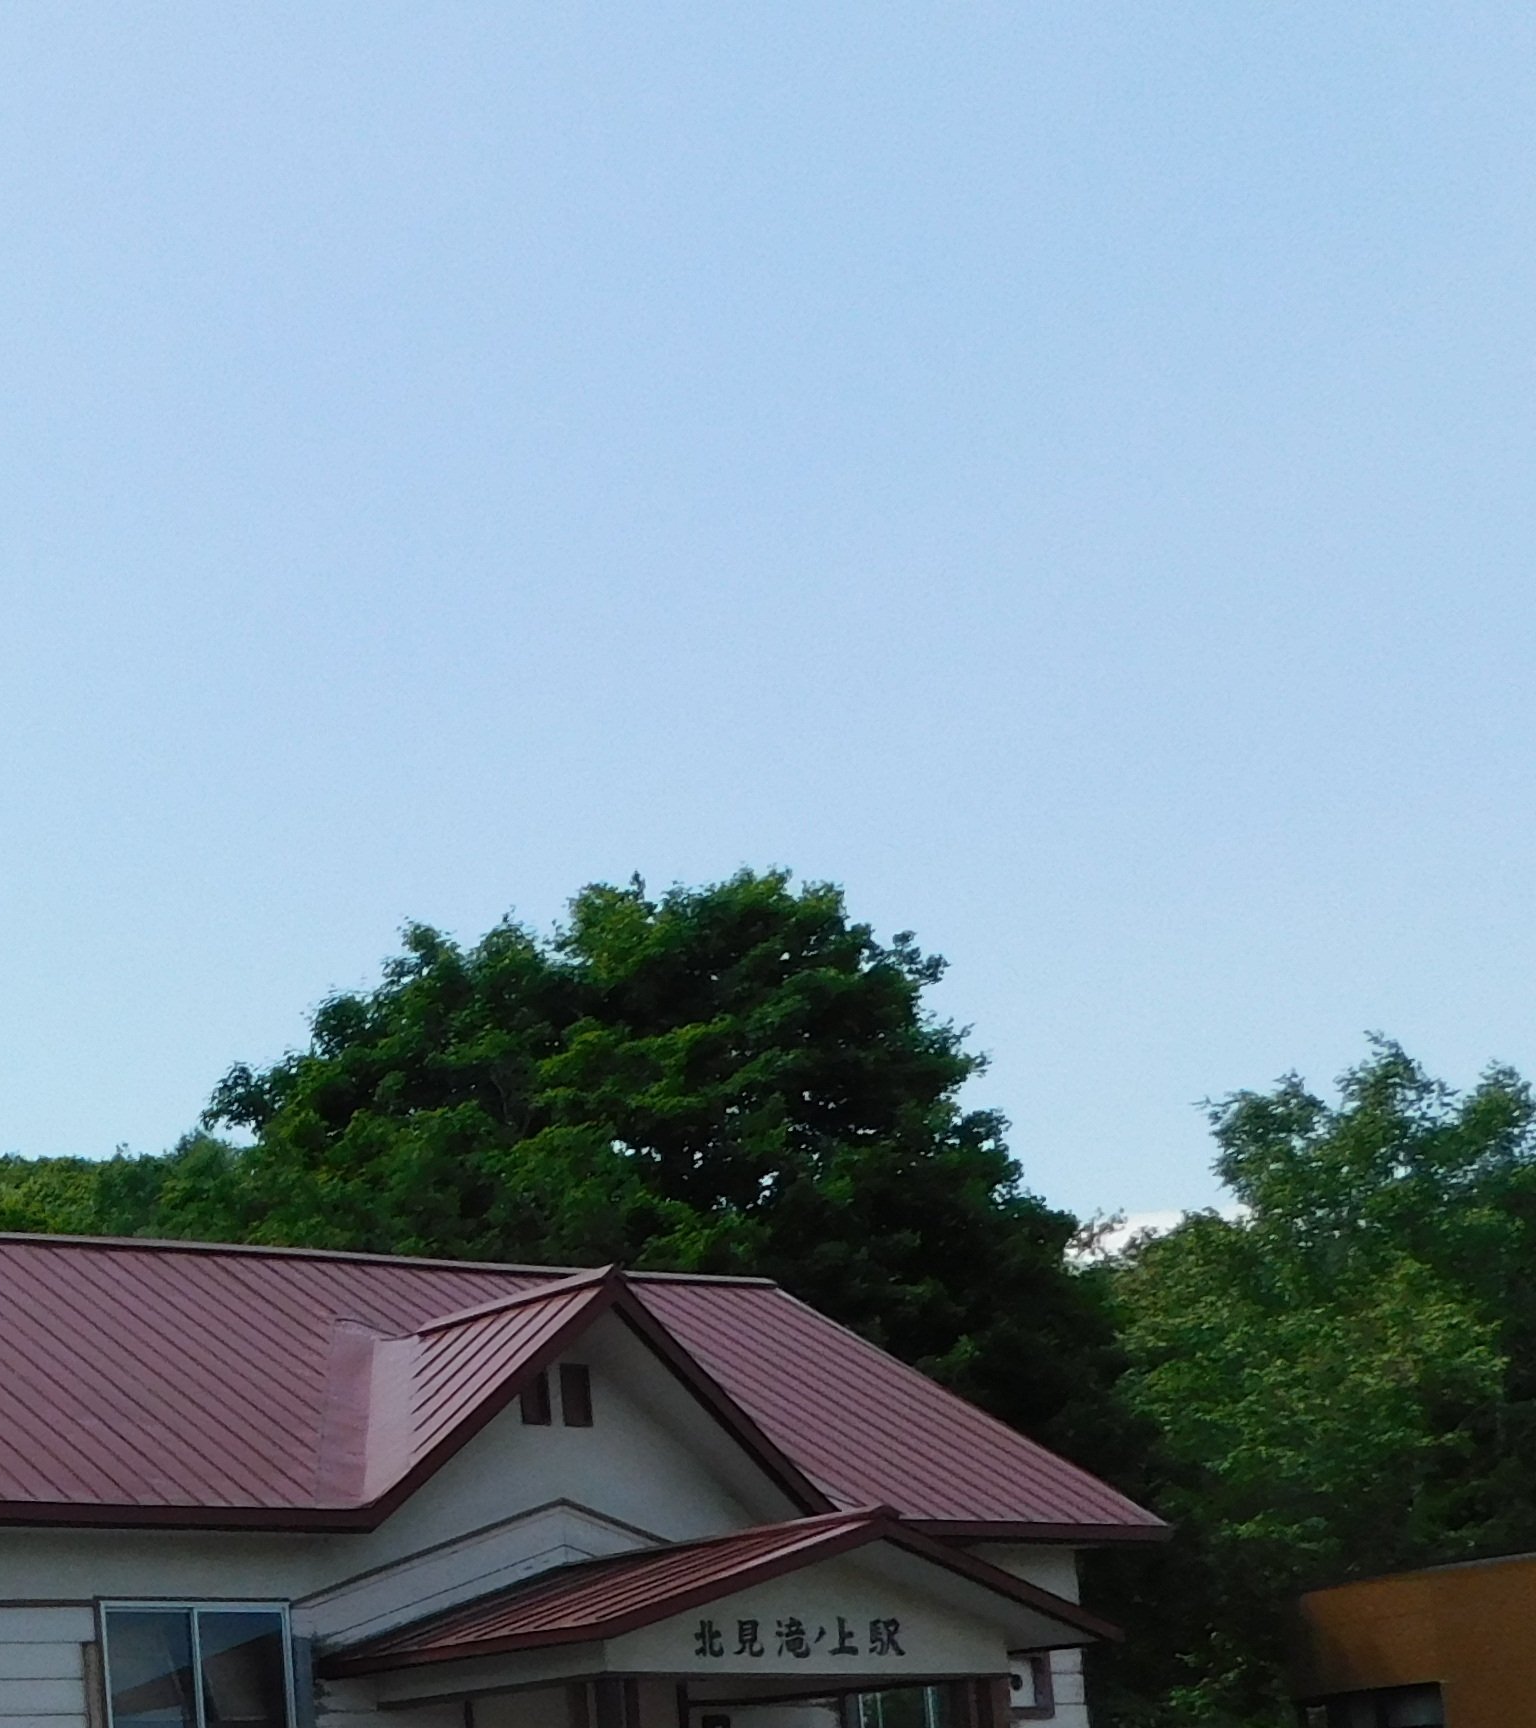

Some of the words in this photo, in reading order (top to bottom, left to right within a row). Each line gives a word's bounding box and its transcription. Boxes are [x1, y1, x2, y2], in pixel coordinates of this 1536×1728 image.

[694, 1616, 906, 1659] 北見滝ノ上駅
